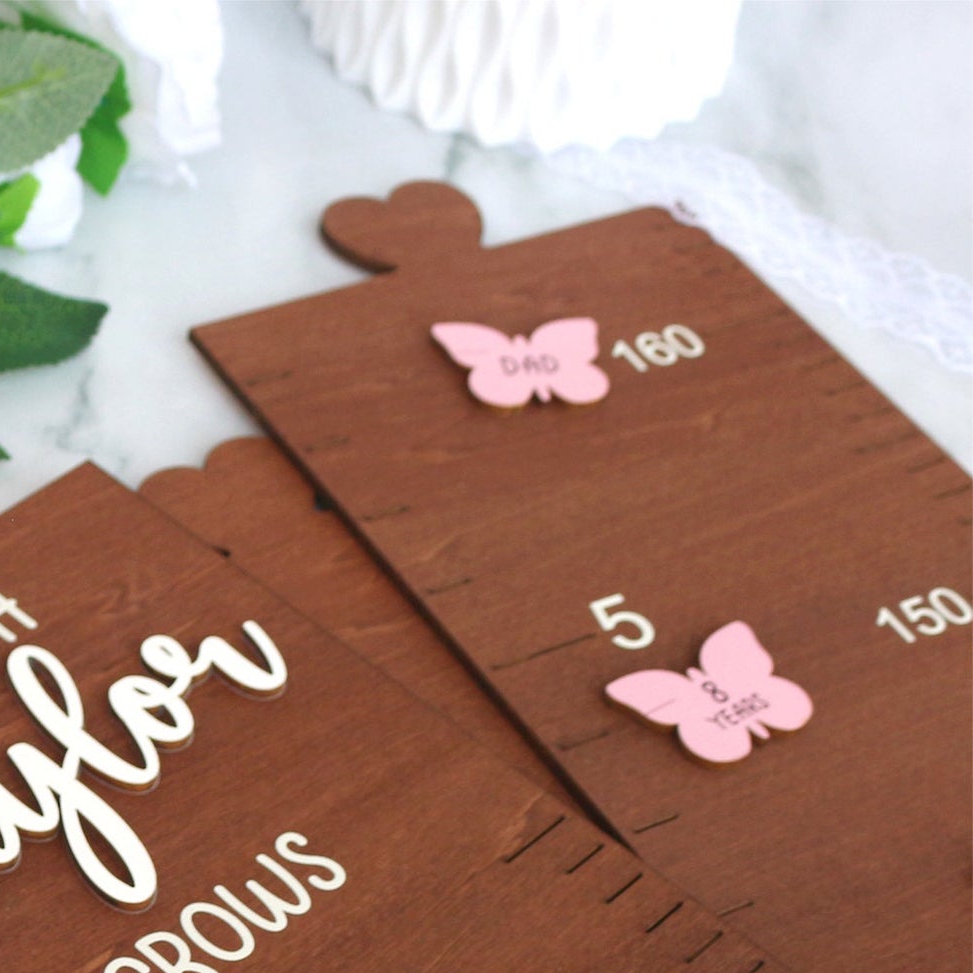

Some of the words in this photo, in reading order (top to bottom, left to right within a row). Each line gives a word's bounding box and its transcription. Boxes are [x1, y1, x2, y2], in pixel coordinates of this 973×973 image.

[500, 353, 559, 377] DAD
[611, 323, 706, 373] 160
[589, 593, 656, 650] 5
[876, 587, 973, 643] 150
[701, 680, 729, 704] 8
[705, 692, 771, 731] YEARS
